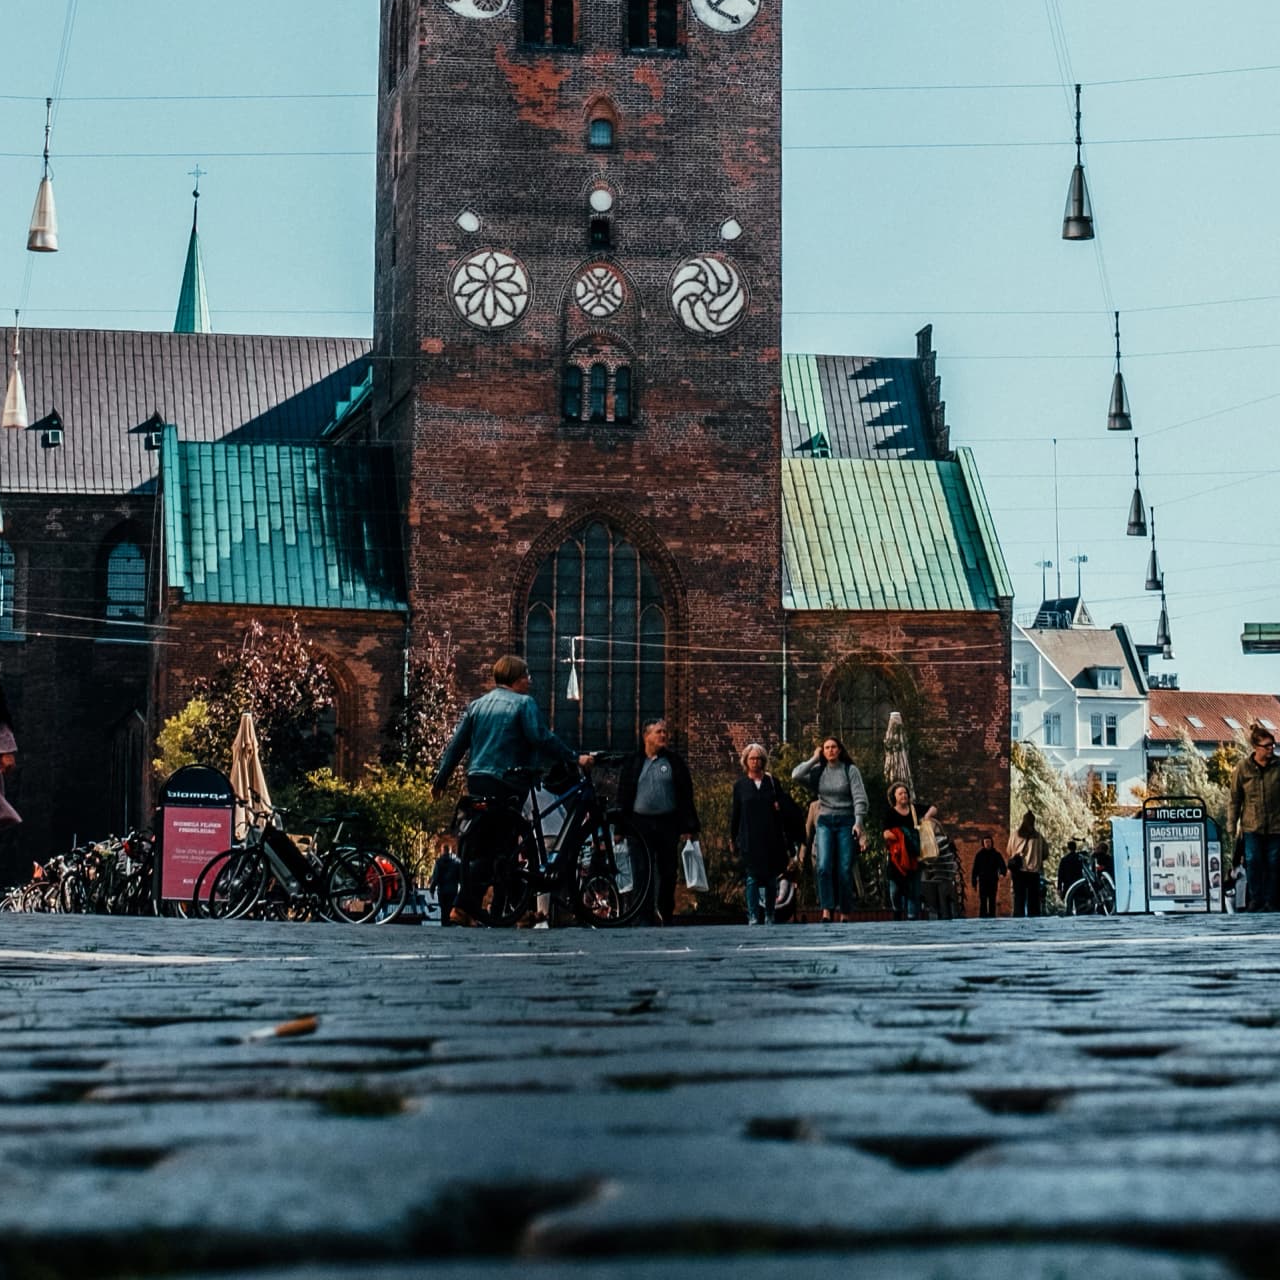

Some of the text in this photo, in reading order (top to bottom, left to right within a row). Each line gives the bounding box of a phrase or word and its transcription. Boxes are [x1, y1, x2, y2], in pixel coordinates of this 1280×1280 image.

[167, 790, 228, 800] biomega
[1156, 808, 1203, 819] IMERCO
[1150, 826, 1200, 837] DAGSTILBUD
